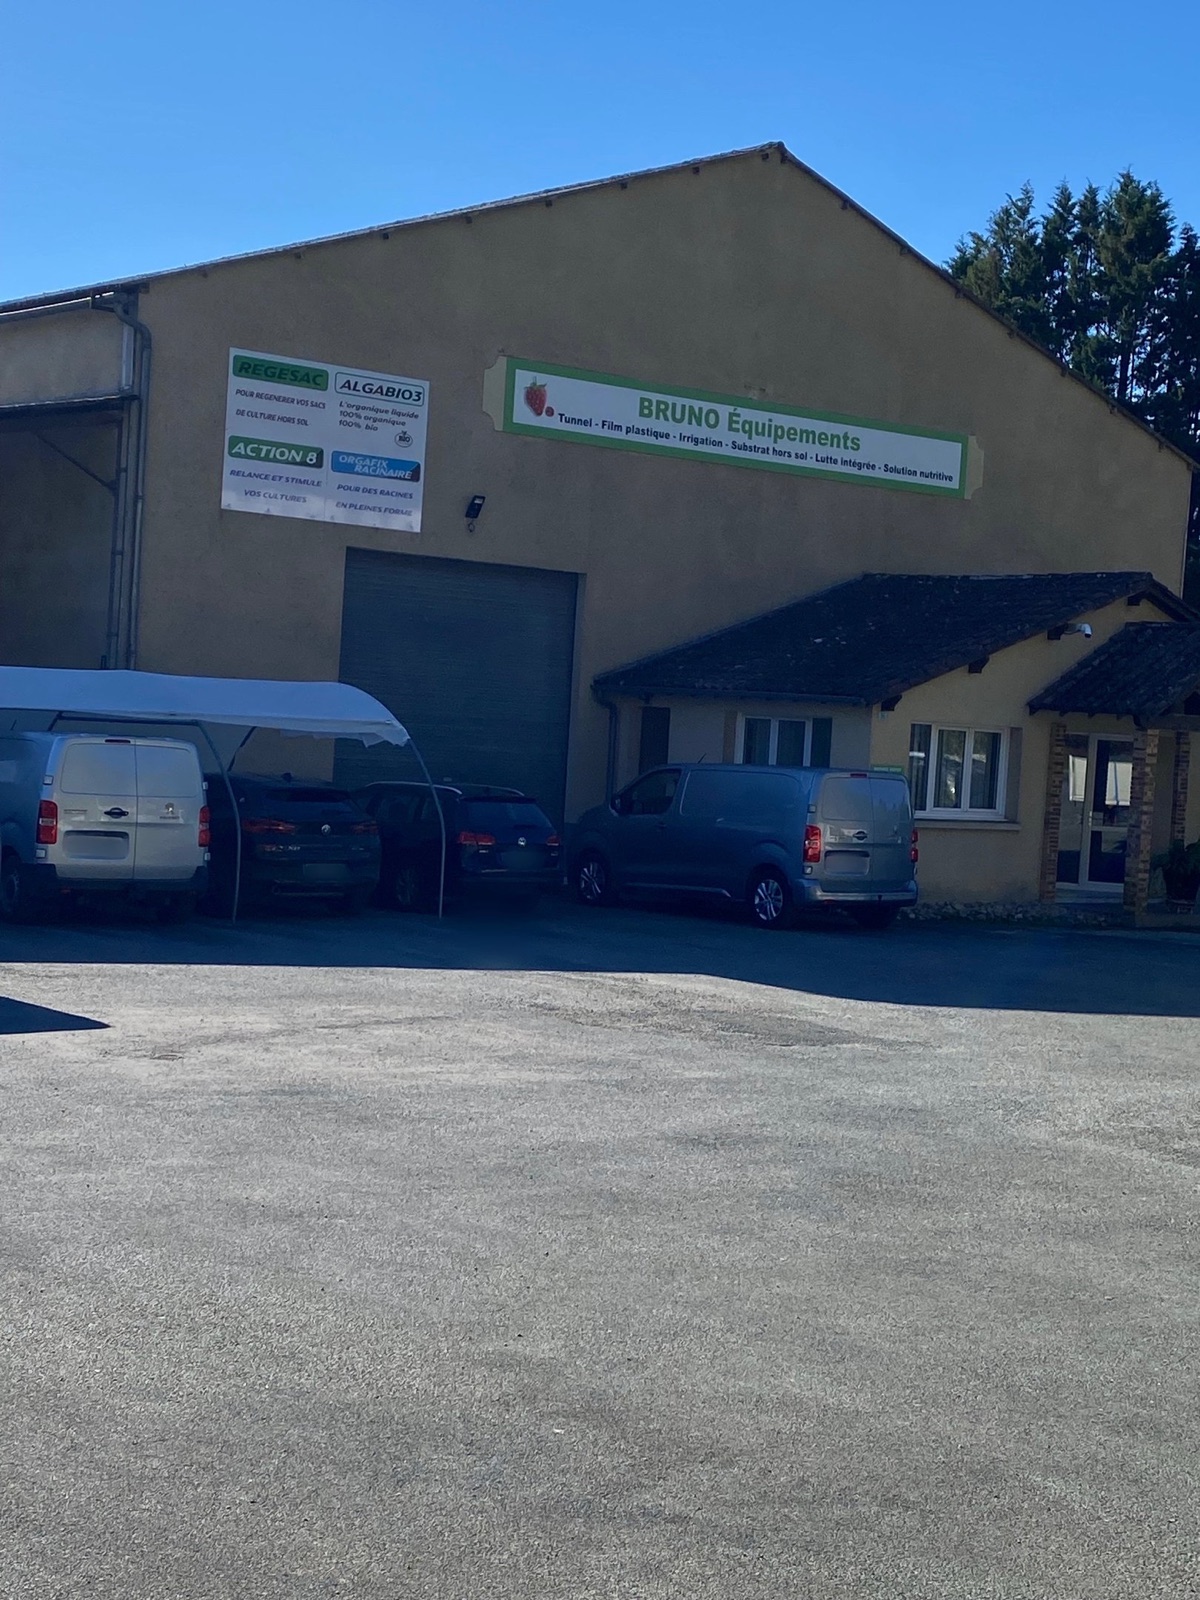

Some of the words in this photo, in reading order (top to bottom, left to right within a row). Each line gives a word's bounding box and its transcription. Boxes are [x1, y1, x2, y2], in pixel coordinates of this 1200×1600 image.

[239, 362, 323, 386] REGESAC
[340, 380, 422, 401] ALGABIO3
[236, 389, 253, 398] POUR
[297, 397, 308, 406] VOS
[310, 399, 325, 409] SACS
[247, 410, 276, 421] CULTURE
[277, 415, 295, 424] HORS
[297, 417, 308, 426] SOL
[339, 401, 389, 415] L'organique
[391, 407, 419, 419] liquide
[339, 410, 362, 420] 100%
[364, 414, 406, 426] organique
[339, 420, 361, 430] 100%
[365, 422, 378, 431] bio
[639, 397, 719, 429] BRUNO
[728, 408, 860, 451] Équipements
[232, 442, 303, 462] ACTION
[306, 452, 316, 464] 8
[558, 413, 592, 427] Tunnel
[601, 420, 622, 432] Film
[625, 425, 670, 440] plastique
[679, 433, 723, 448] Irrigation
[732, 441, 770, 455] Substrat
[772, 447, 791, 458] hors
[795, 451, 807, 460] sol
[816, 453, 838, 465] Lutte
[841, 456, 876, 471] intégrée
[884, 464, 917, 477] Solution
[920, 471, 953, 482] nutritive
[339, 455, 388, 467] ORGAFIX
[230, 470, 269, 481] RELANCE
[272, 474, 283, 482] ET
[285, 476, 322, 487] STIMULE
[355, 464, 412, 479] RACINAIRE
[244, 490, 261, 498] VOS
[263, 491, 307, 503] CULTURES
[337, 484, 360, 493] POUR
[362, 487, 377, 495] DES
[379, 489, 413, 499] RACINES
[336, 501, 350, 509] EN
[350, 503, 382, 513] PLEINES
[384, 507, 412, 516] FORME
